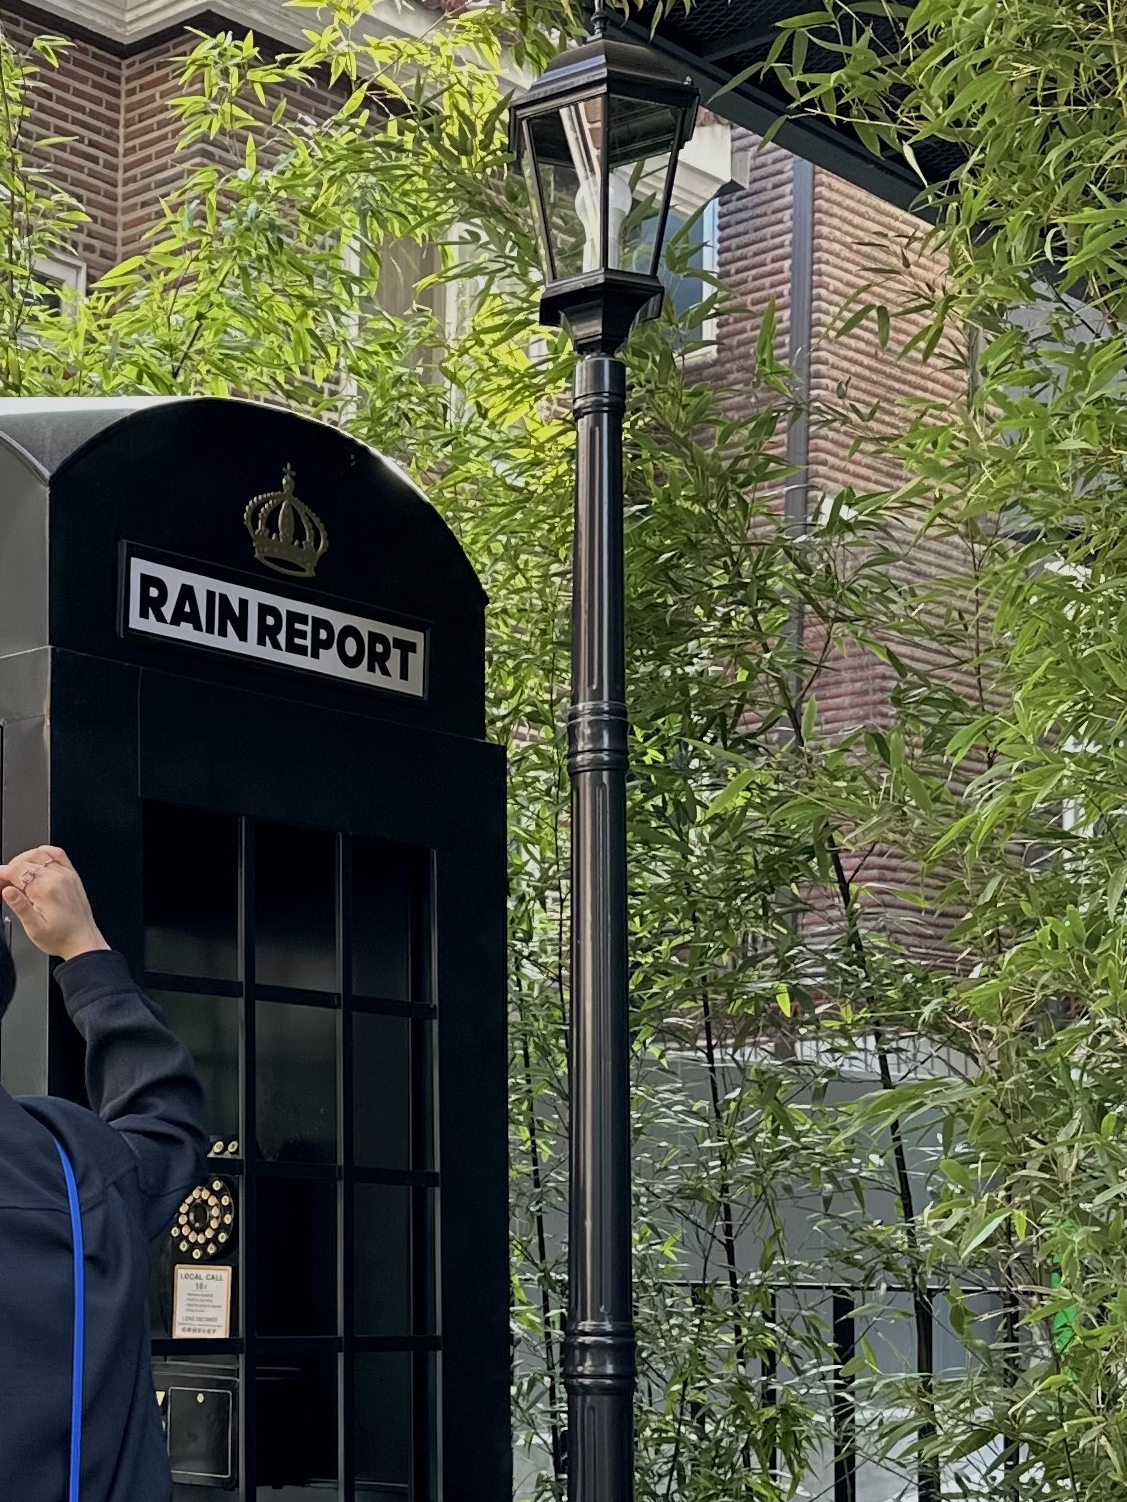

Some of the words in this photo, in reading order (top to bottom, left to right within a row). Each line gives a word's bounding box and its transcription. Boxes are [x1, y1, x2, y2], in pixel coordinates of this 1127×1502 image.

[139, 575, 250, 642] RAIN
[257, 606, 417, 681] REPORT
[180, 1273, 203, 1281] LOCAL
